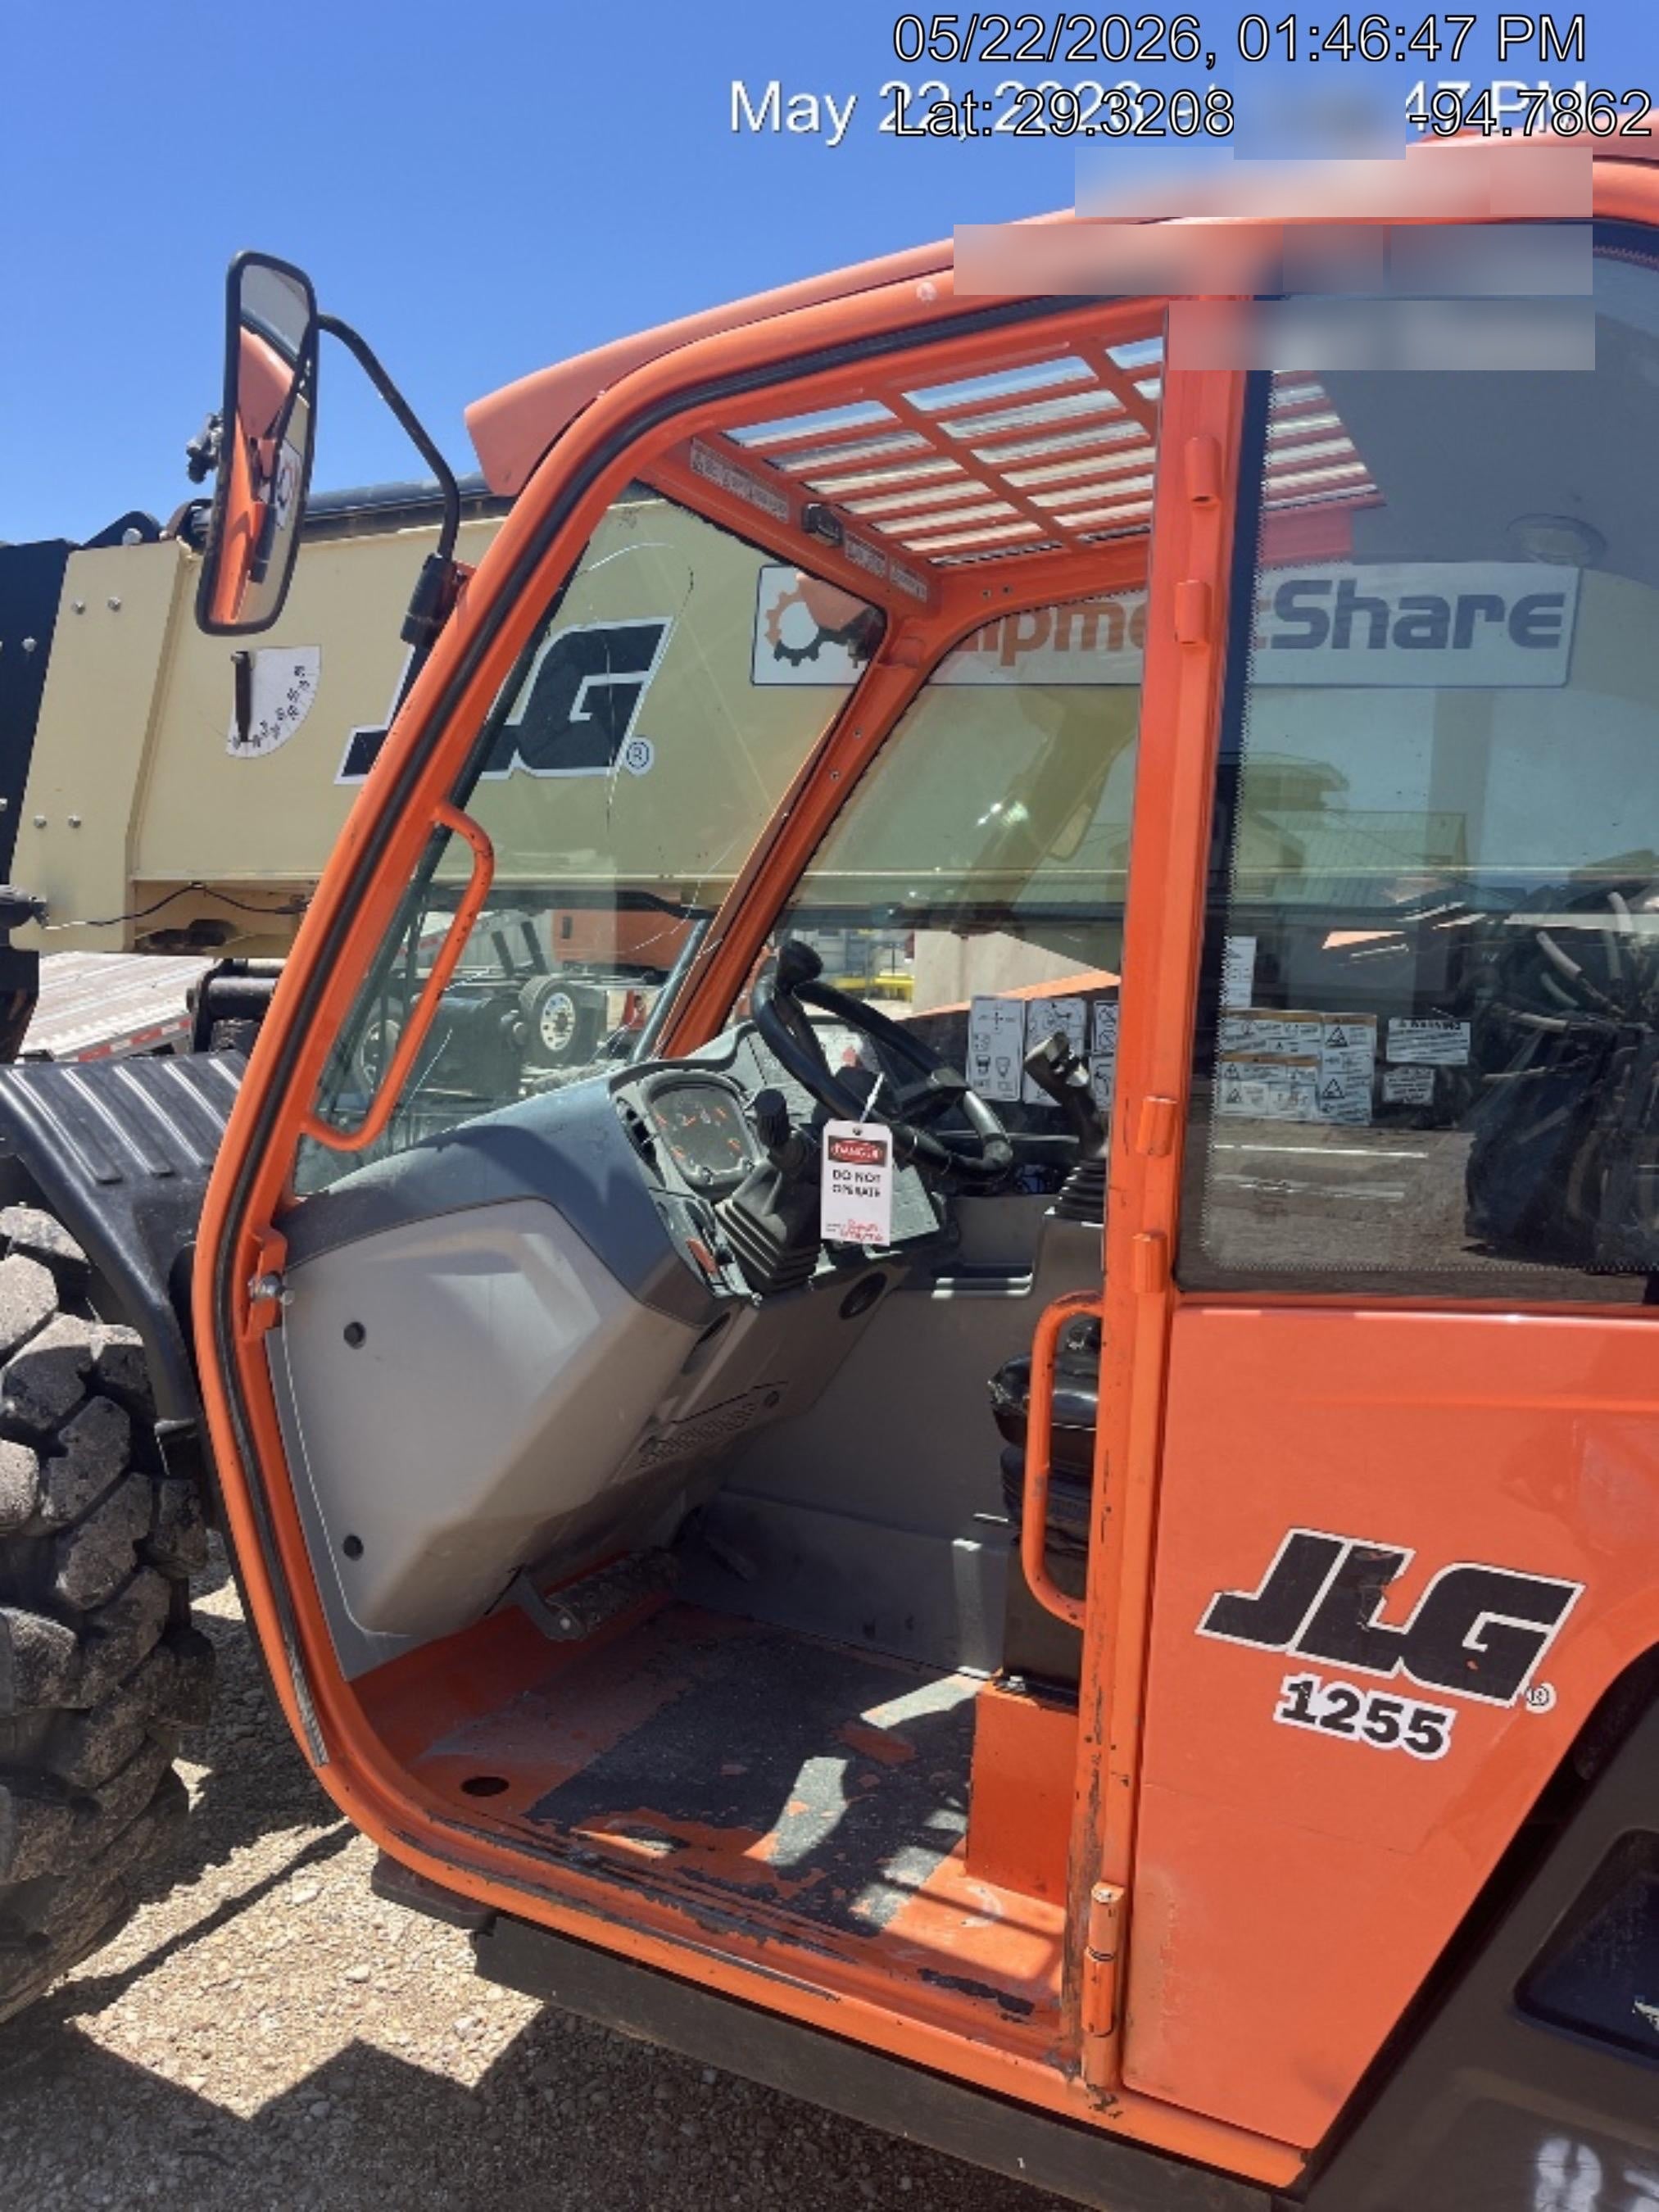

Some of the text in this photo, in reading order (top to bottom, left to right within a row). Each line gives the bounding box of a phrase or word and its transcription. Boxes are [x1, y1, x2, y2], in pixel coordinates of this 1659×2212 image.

[832, 1169, 881, 1184] DO NOT
[832, 1184, 881, 1198] OPERATE
[1195, 1526, 1585, 1708] JLG
[1278, 1677, 1451, 1757] 1255
